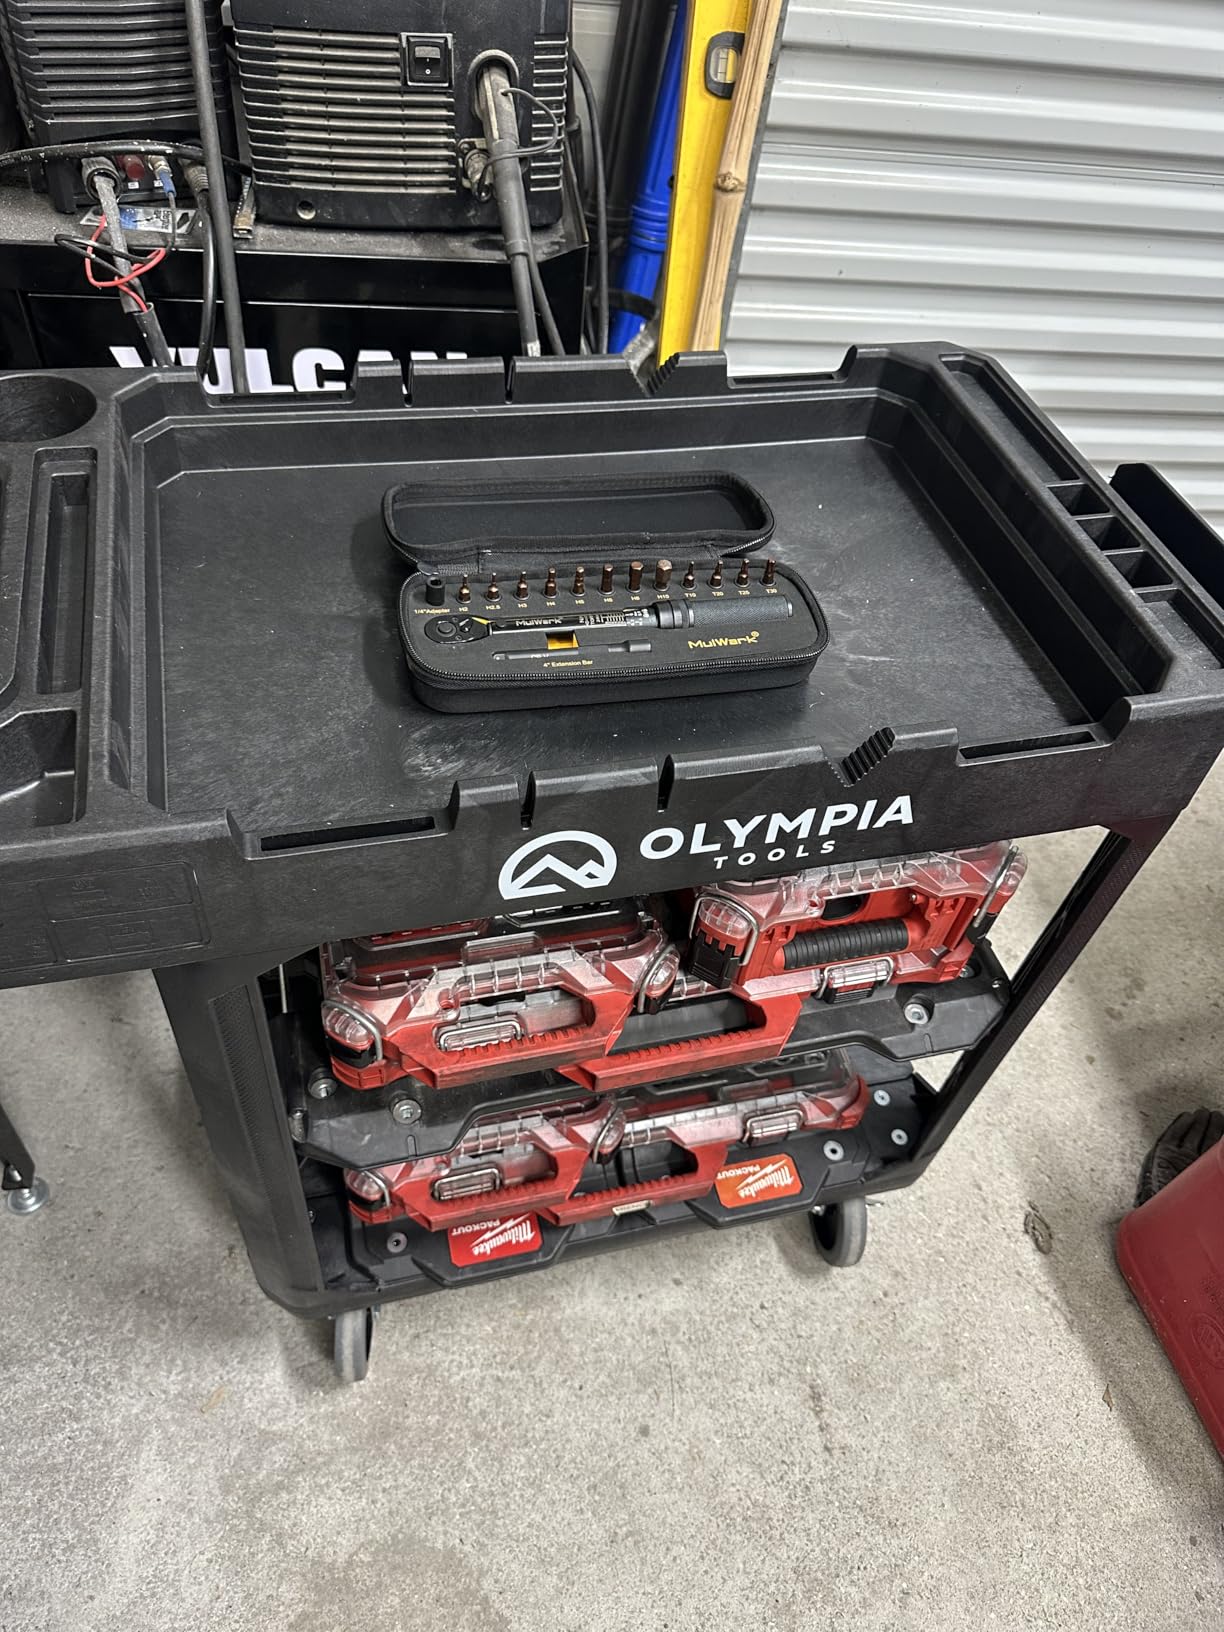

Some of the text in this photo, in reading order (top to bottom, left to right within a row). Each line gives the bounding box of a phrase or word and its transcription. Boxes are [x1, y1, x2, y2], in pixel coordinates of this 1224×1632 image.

[639, 795, 914, 860] OLYMPIA
[713, 840, 836, 870] TOOLS
[717, 1164, 760, 1180] PACKOUT
[737, 1165, 794, 1198] Milwaukee
[452, 1218, 501, 1236] PACKOUT
[471, 1219, 535, 1256] Milwaukee
